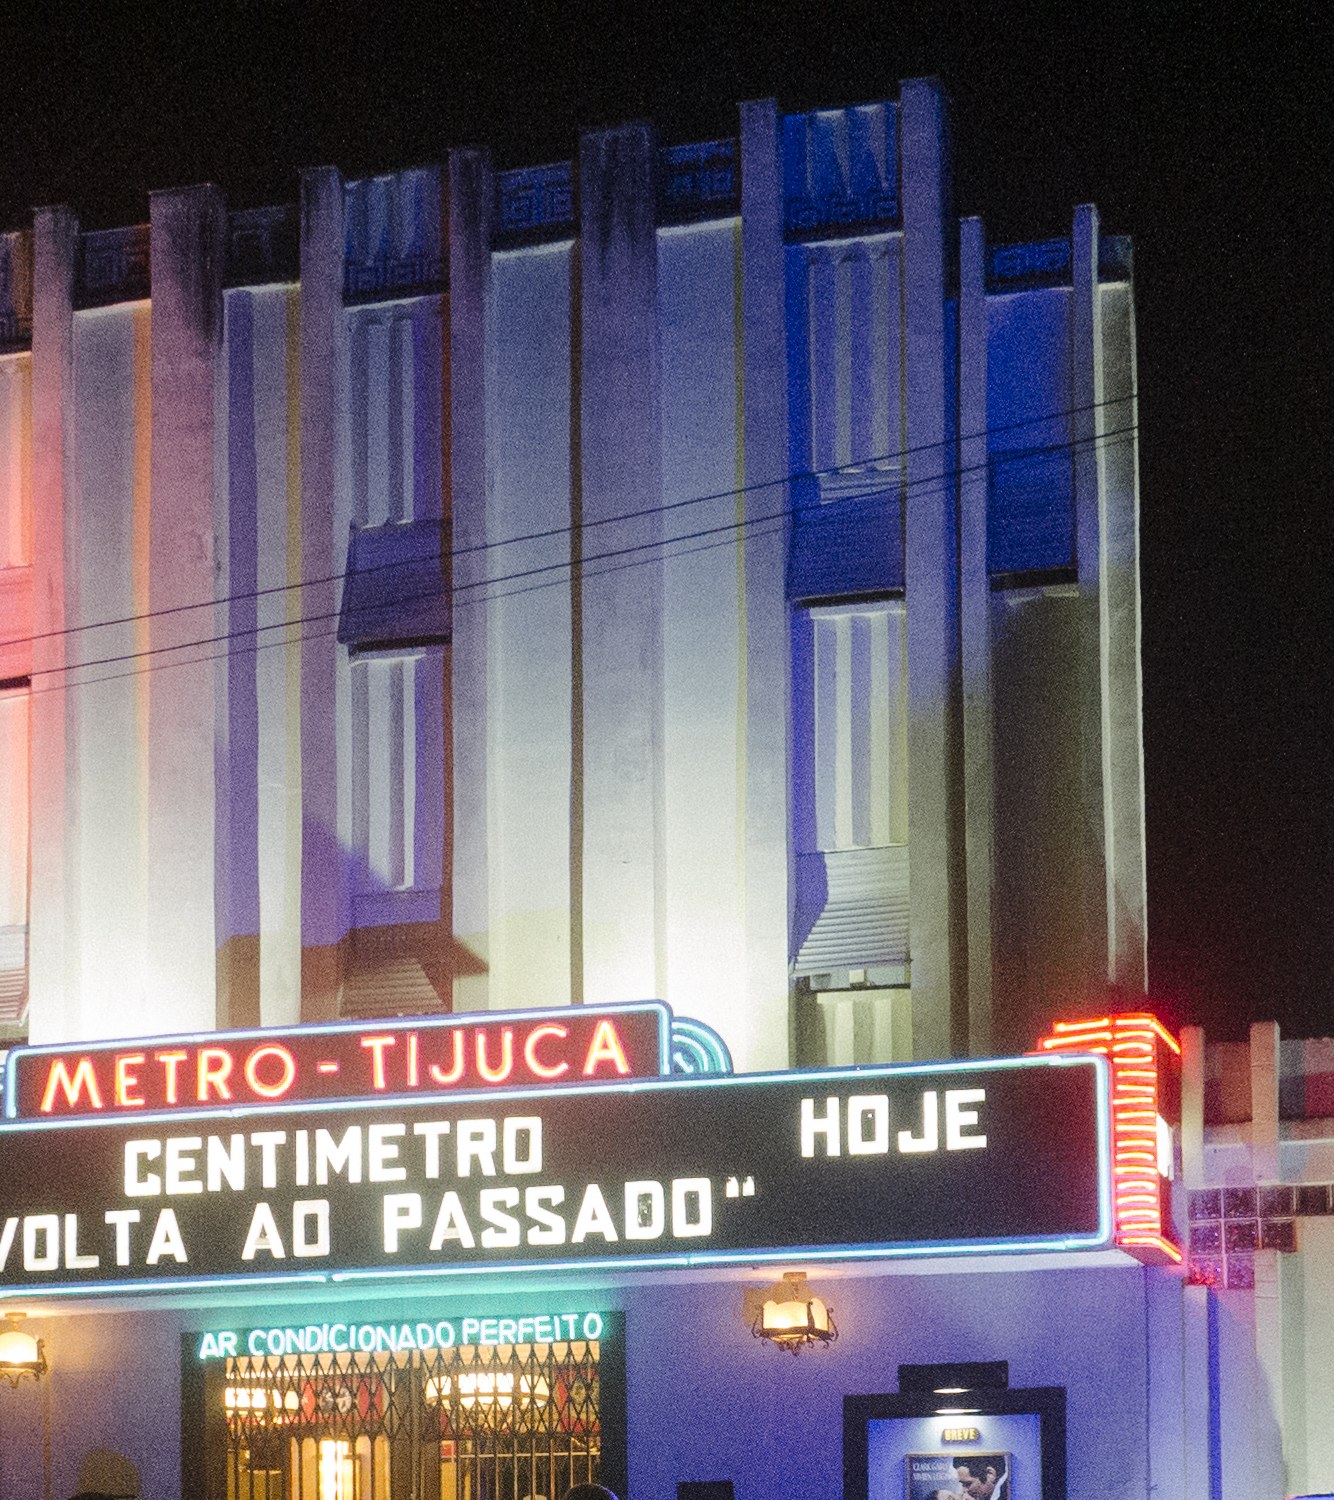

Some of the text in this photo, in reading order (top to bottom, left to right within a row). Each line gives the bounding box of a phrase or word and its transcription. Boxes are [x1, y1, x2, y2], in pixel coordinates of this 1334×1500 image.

[39, 1043, 297, 1113] METRO
[360, 1020, 632, 1090] TIJUCA
[799, 1088, 988, 1158] HOJE
[123, 1116, 543, 1198] CENTIMETRO
[241, 1199, 331, 1262] AO
[198, 1312, 604, 1361] AR CONDICIONADO PERFEITO
[944, 1427, 976, 1441] BREVE
